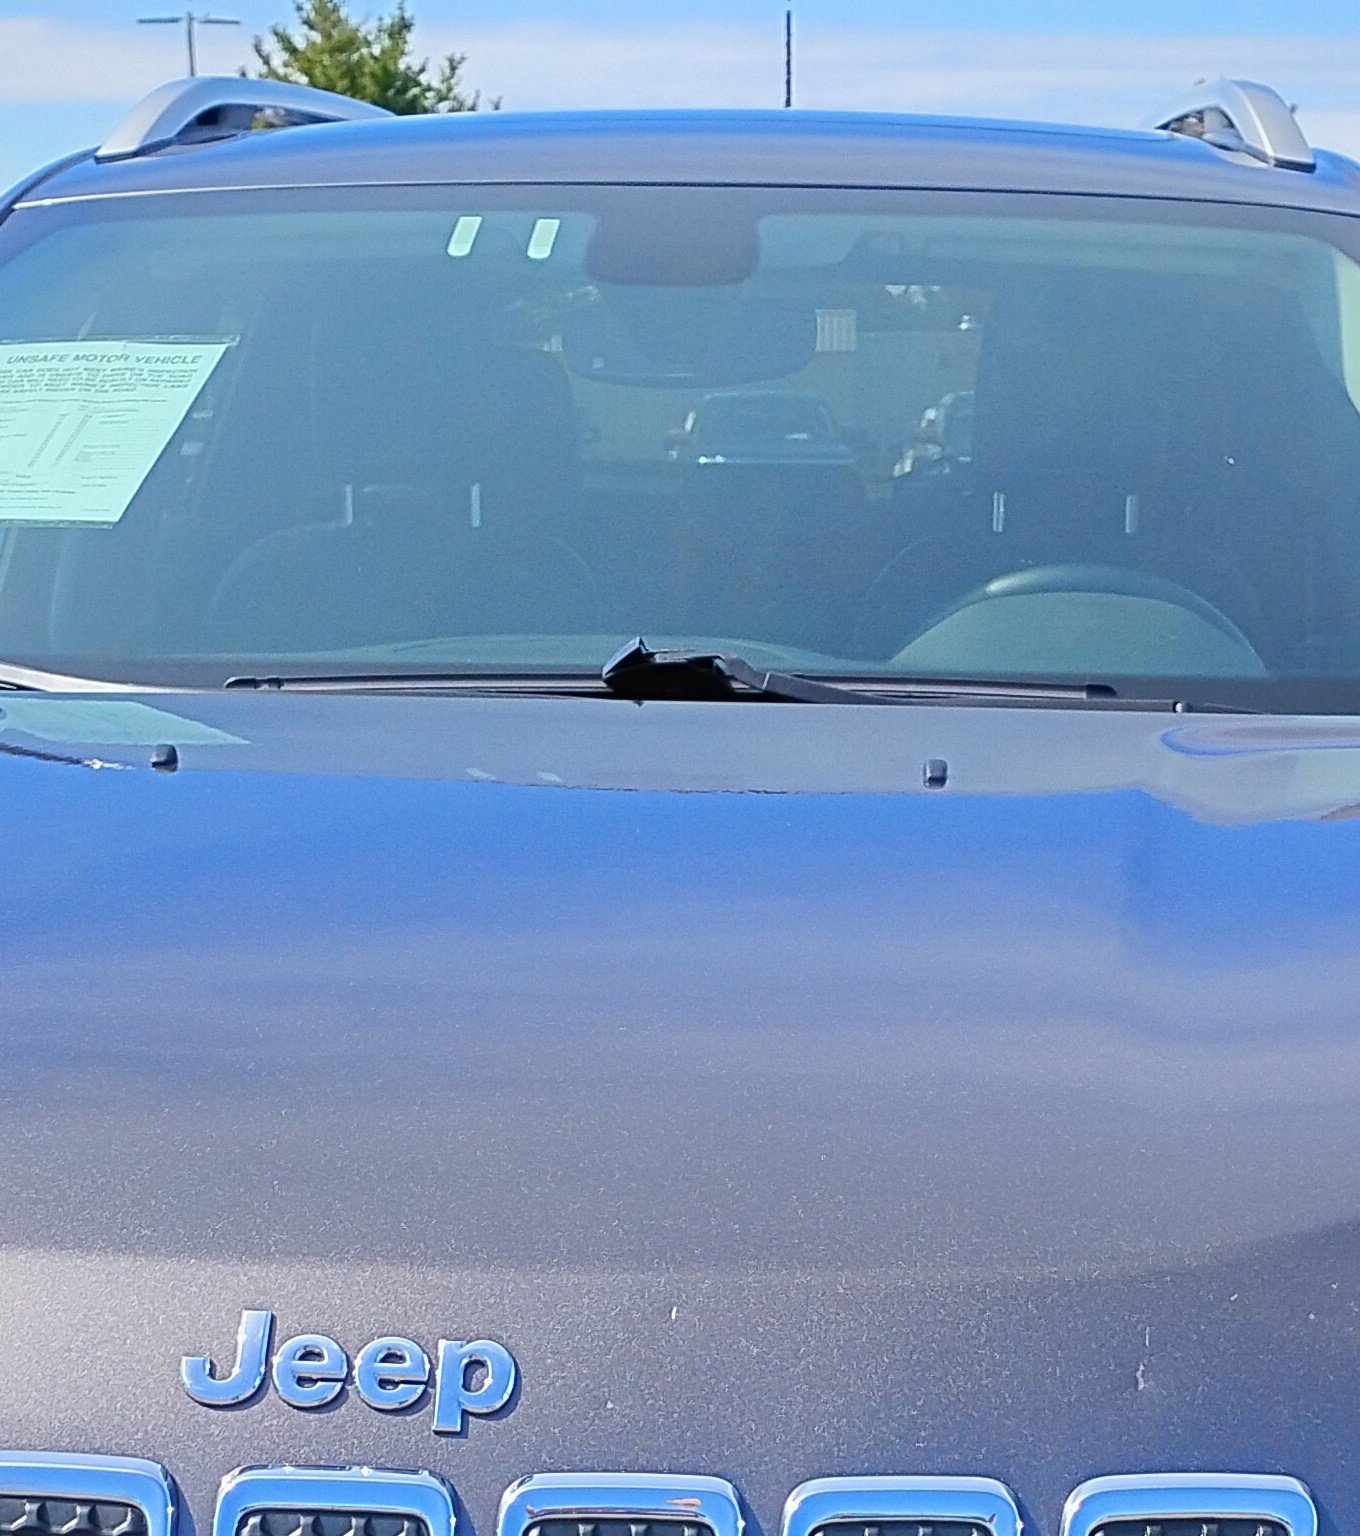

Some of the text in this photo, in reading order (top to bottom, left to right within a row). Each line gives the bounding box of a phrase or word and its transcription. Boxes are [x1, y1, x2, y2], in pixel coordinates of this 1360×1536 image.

[6, 353, 202, 365] UNSAFE MOTOR VEHICLE
[181, 1308, 517, 1434] Jeep
